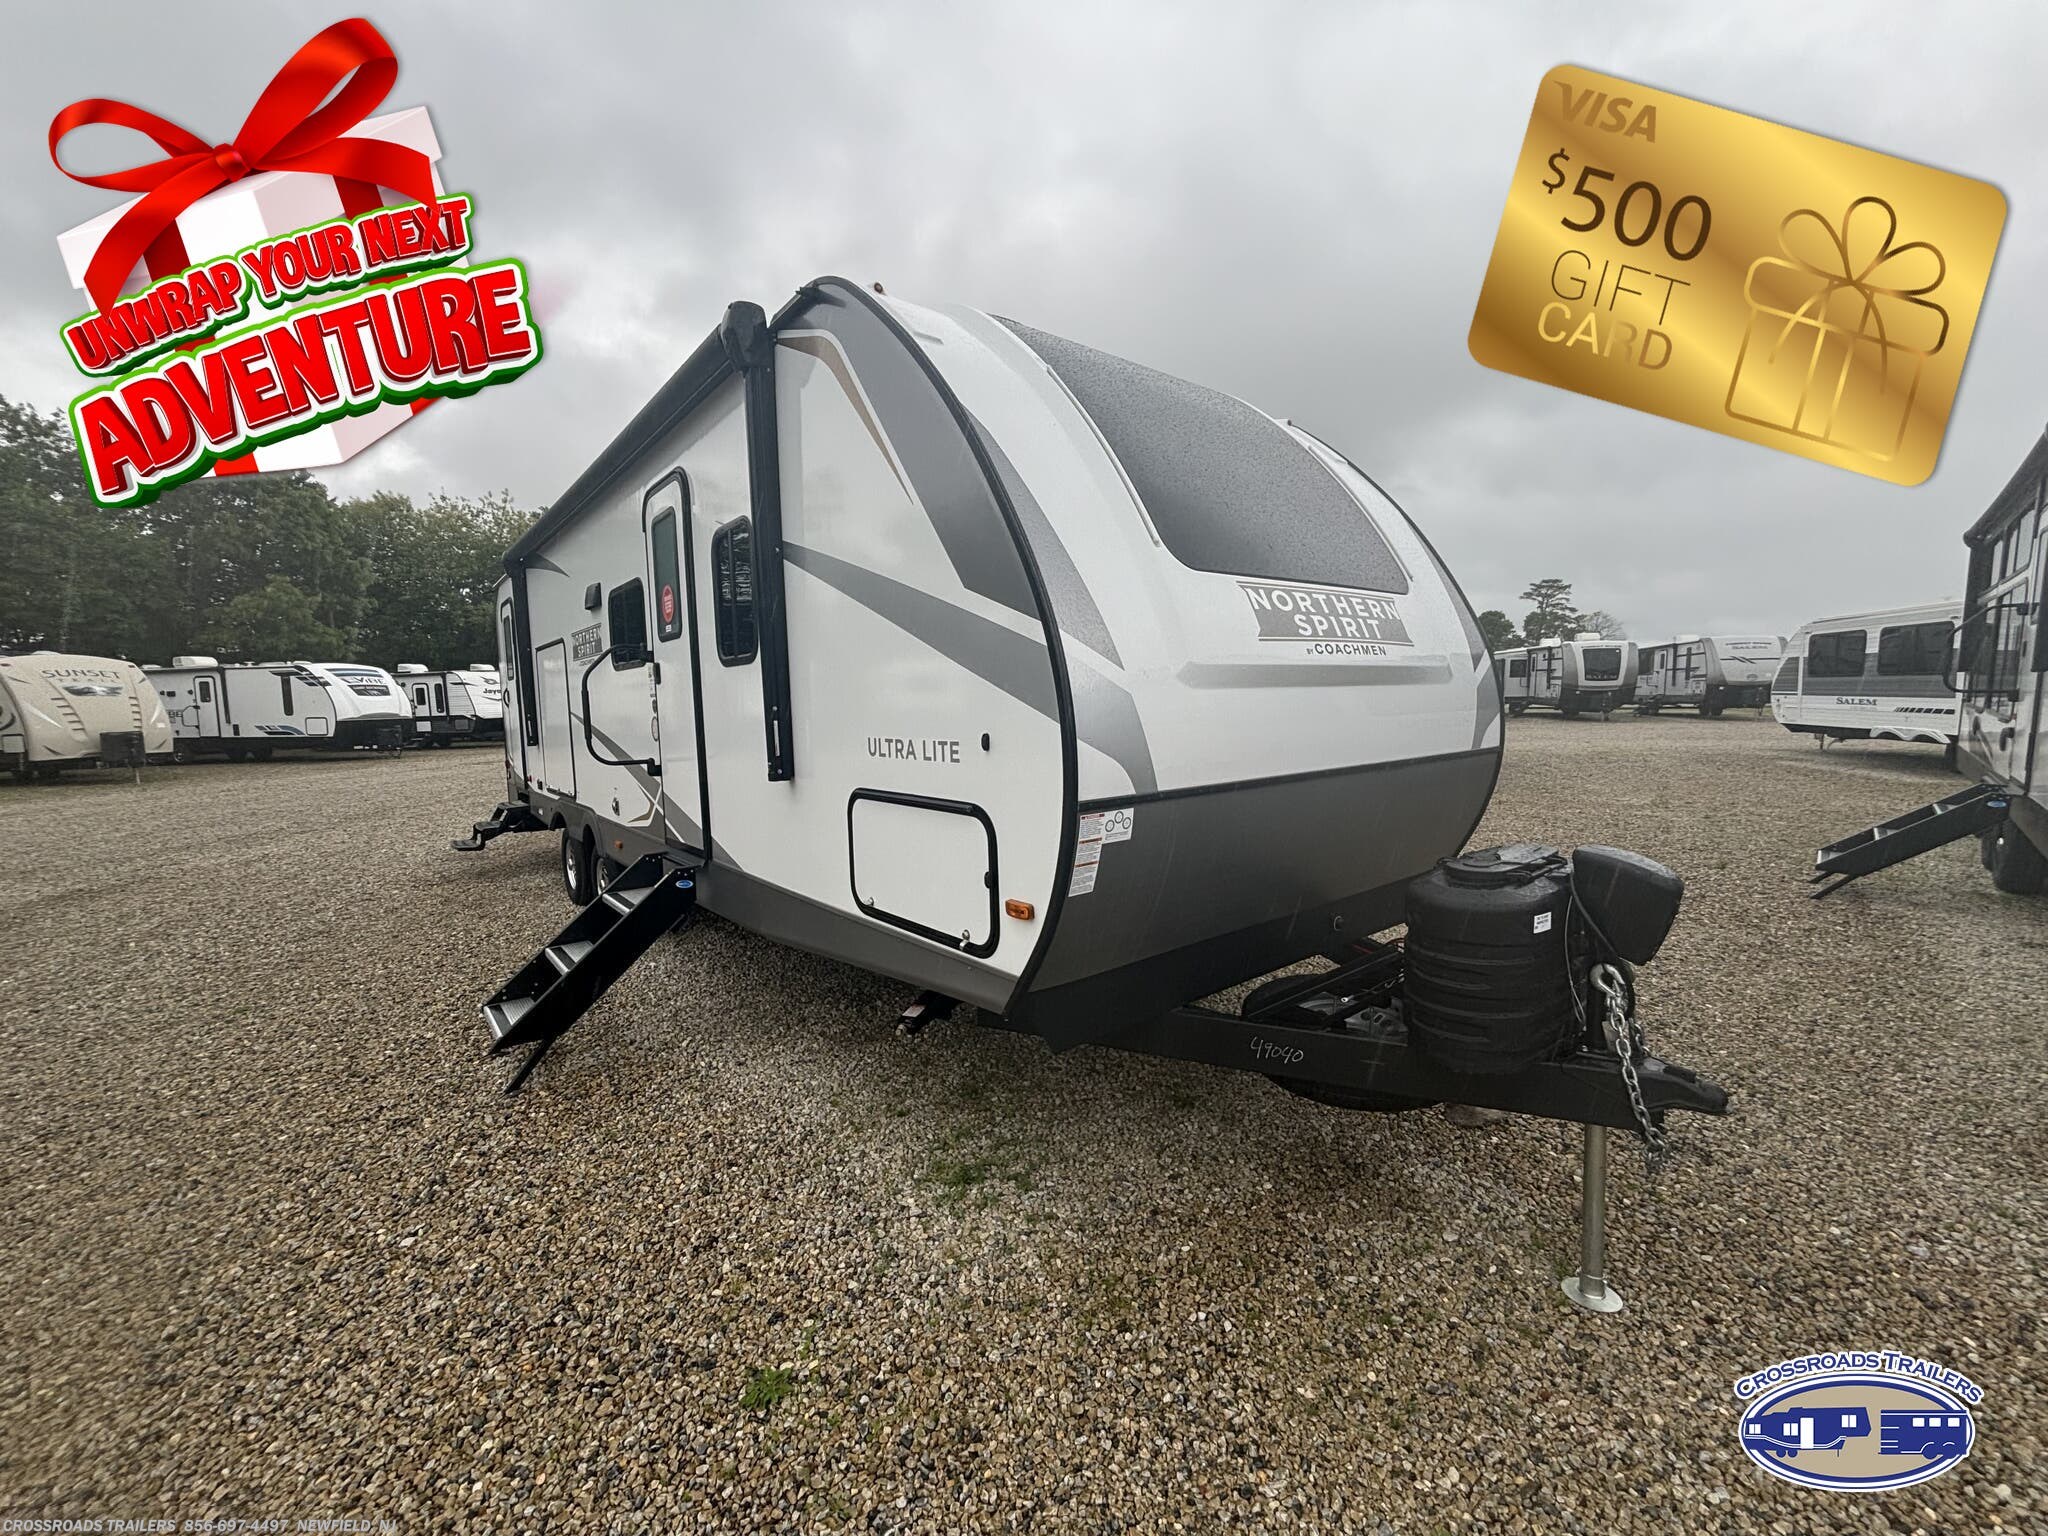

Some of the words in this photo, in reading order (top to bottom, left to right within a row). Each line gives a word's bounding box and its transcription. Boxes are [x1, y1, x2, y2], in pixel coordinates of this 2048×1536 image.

[1244, 587, 1401, 620] NORTHERN
[1293, 613, 1382, 640] SPIRIT
[1314, 643, 1387, 656] COACHMEN
[41, 669, 121, 679] SUNSET
[1836, 696, 1878, 706] SALEM
[867, 737, 917, 761] ULTRA
[922, 739, 960, 764] LITE
